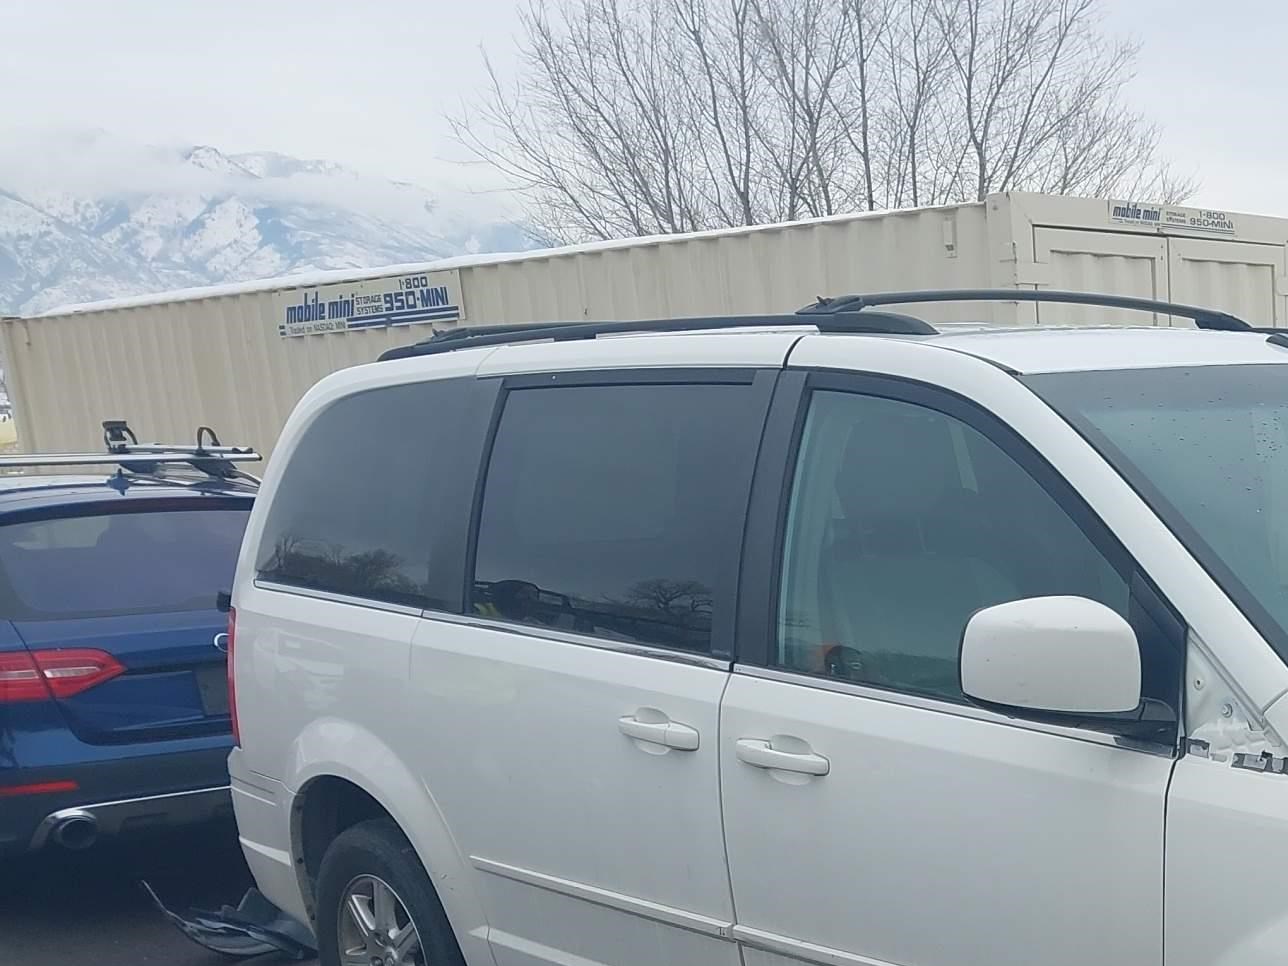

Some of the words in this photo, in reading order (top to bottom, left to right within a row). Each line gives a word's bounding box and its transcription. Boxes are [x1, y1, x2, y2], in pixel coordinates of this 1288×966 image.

[1113, 203, 1141, 219] mobile
[1142, 207, 1161, 221] mini
[1200, 211, 1226, 221] 1-800
[1190, 217, 1234, 229] 950-MINI
[356, 295, 382, 306] STORAGE
[287, 291, 325, 324] mobile
[328, 293, 355, 321] mini
[357, 305, 384, 315] SYSTEMS
